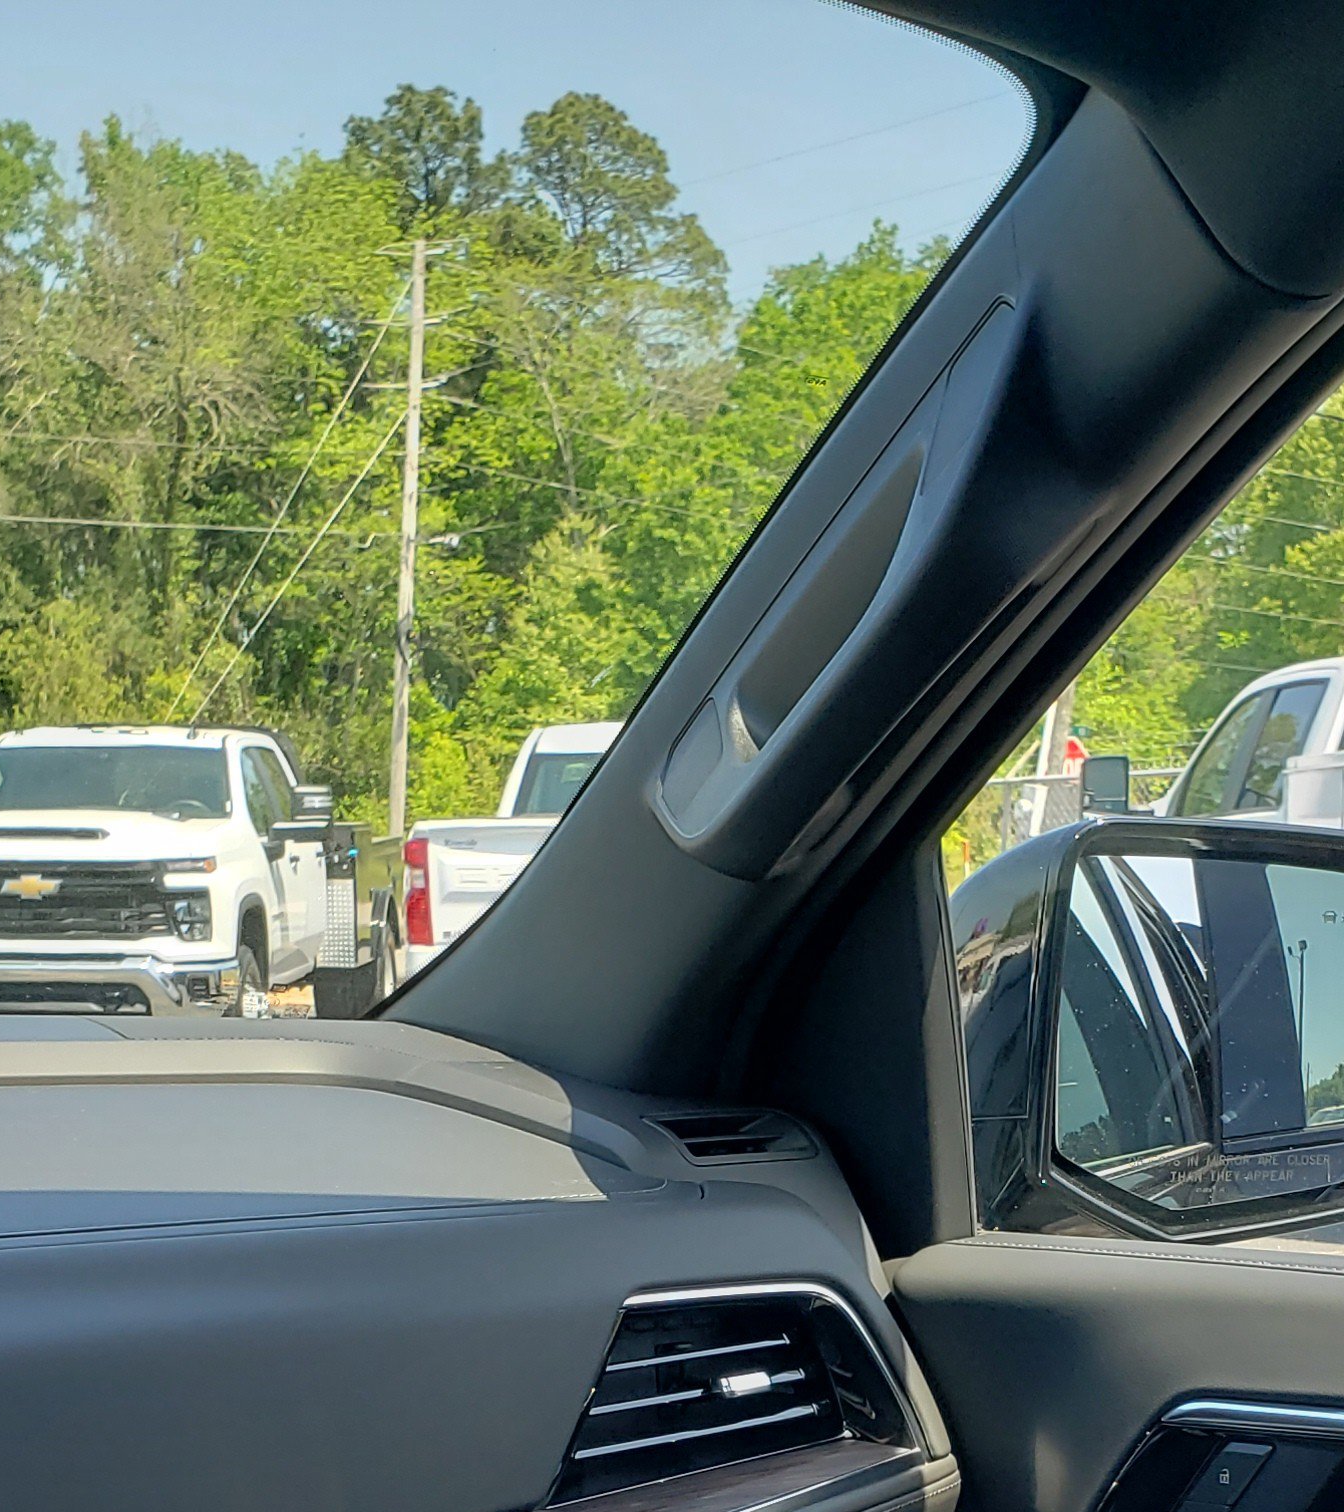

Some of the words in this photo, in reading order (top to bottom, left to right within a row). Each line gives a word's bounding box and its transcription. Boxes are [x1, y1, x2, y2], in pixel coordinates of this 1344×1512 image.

[1187, 1155, 1199, 1167] IN
[1257, 1154, 1279, 1166] ARE
[1288, 1153, 1330, 1166] CLOSER
[1170, 1170, 1203, 1183] THAN
[1210, 1170, 1240, 1182] THEY
[1246, 1169, 1294, 1182] APPEAR
